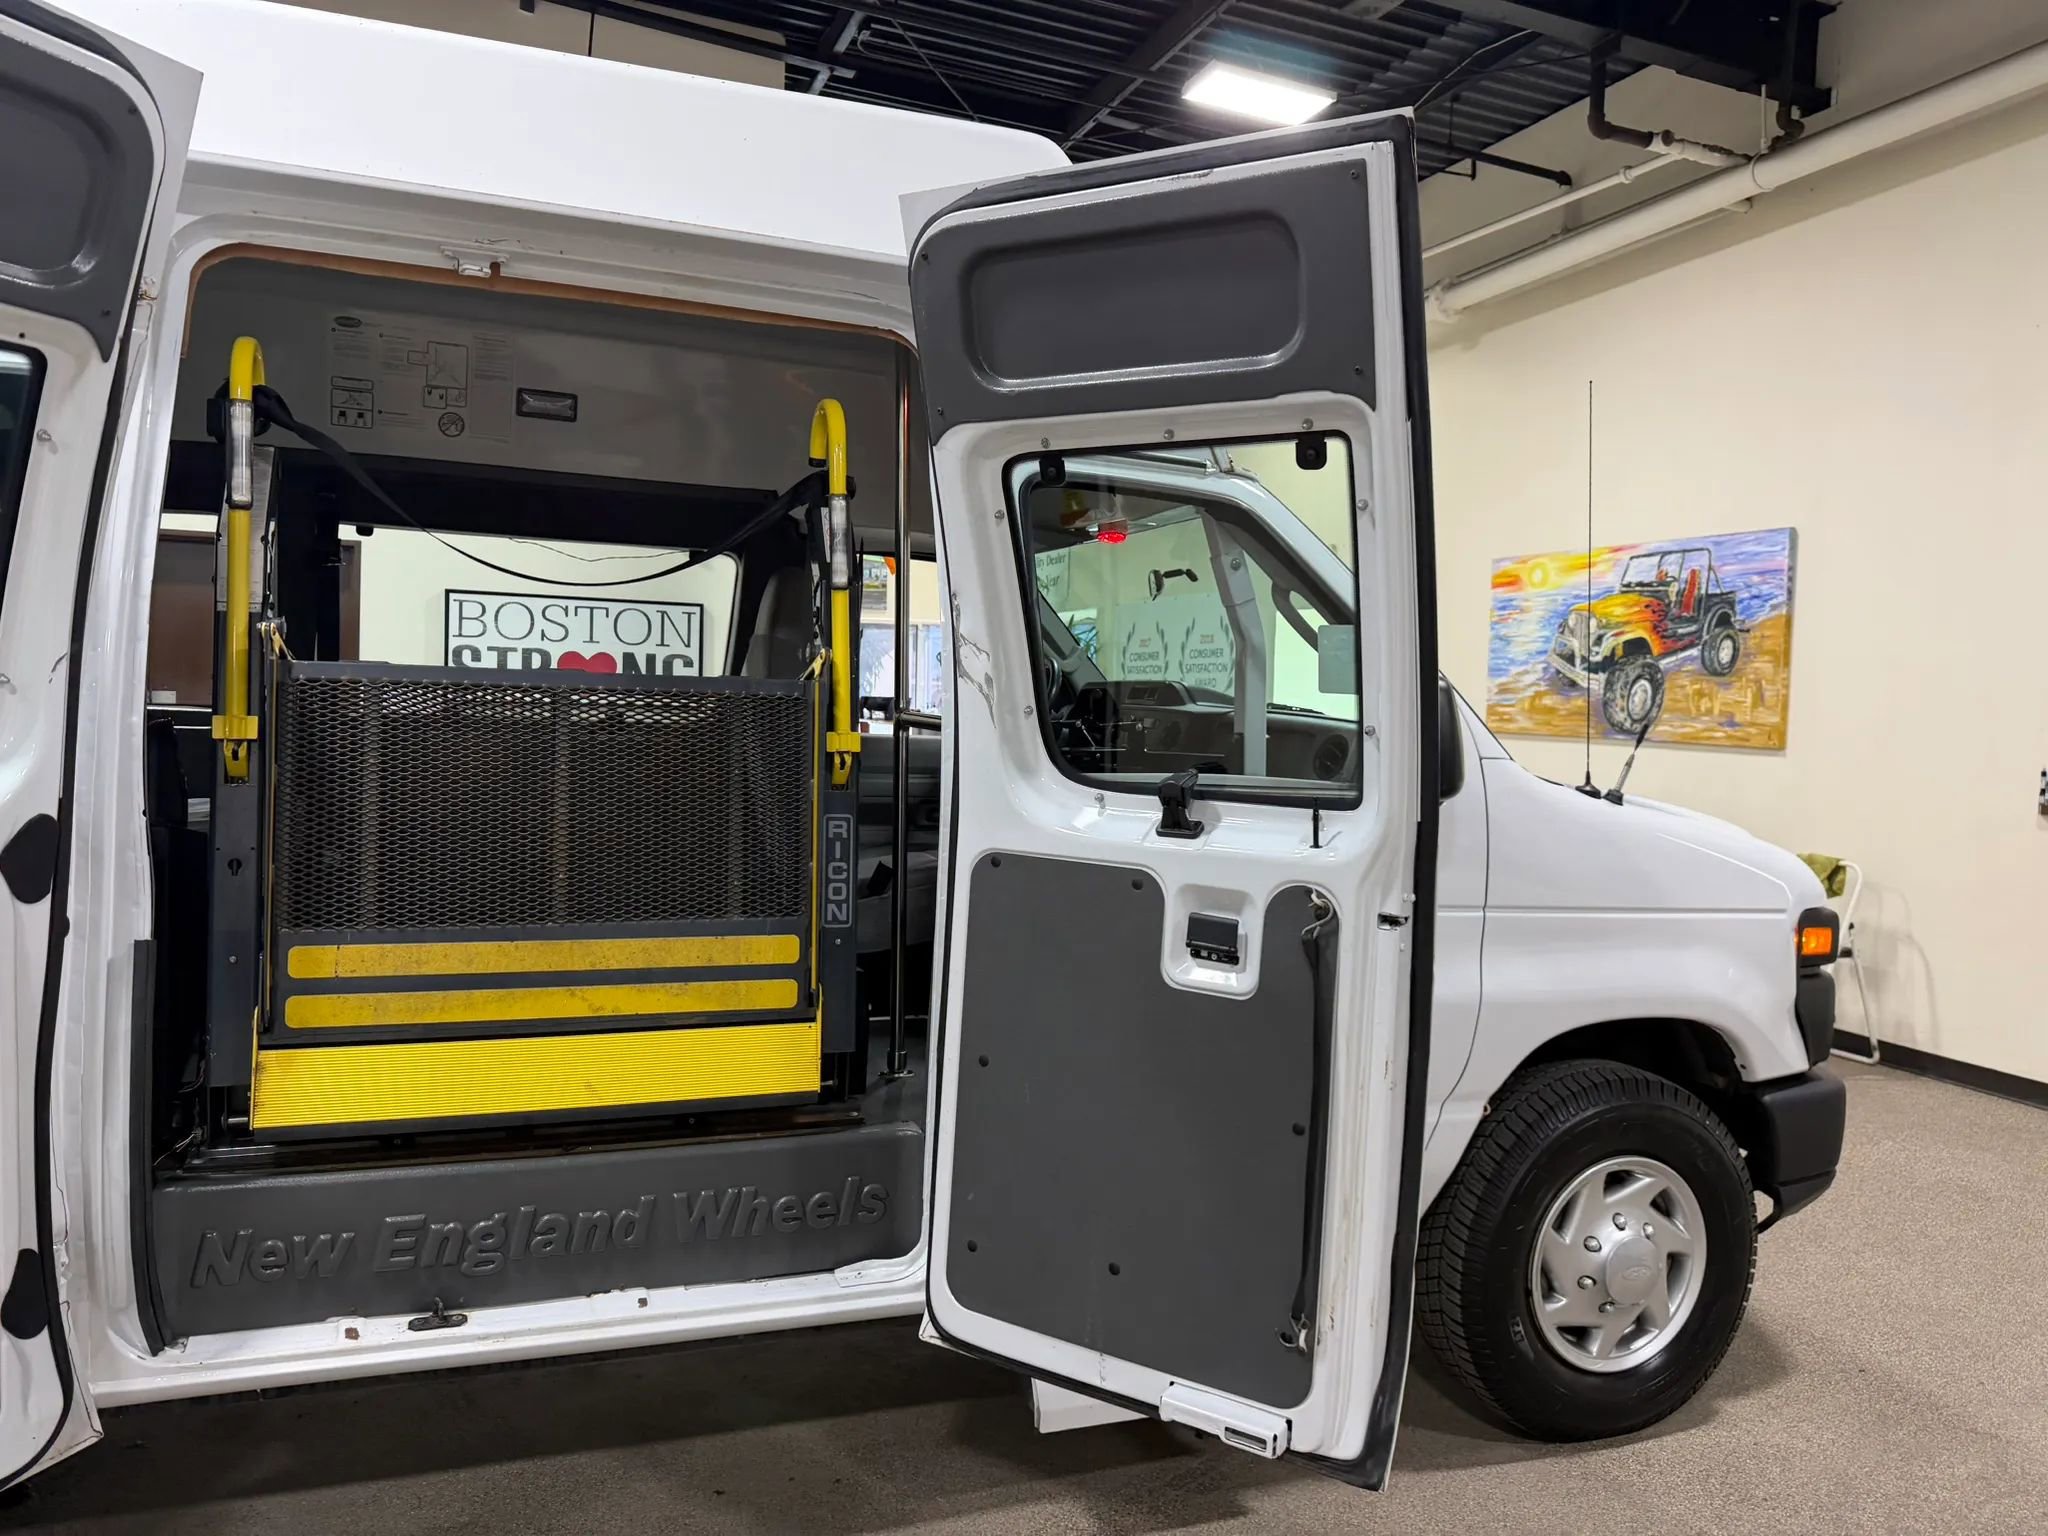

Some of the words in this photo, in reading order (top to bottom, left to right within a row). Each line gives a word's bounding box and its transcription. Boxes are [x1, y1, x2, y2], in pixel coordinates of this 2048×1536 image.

[452, 599, 696, 648] BOSTON
[1185, 663, 1229, 674] SATISFACTION
[1189, 648, 1224, 659] CONSUMER
[827, 820, 848, 921] RICON
[190, 1228, 355, 1289] New
[374, 1193, 656, 1277] England
[673, 1175, 890, 1243] Wheels
